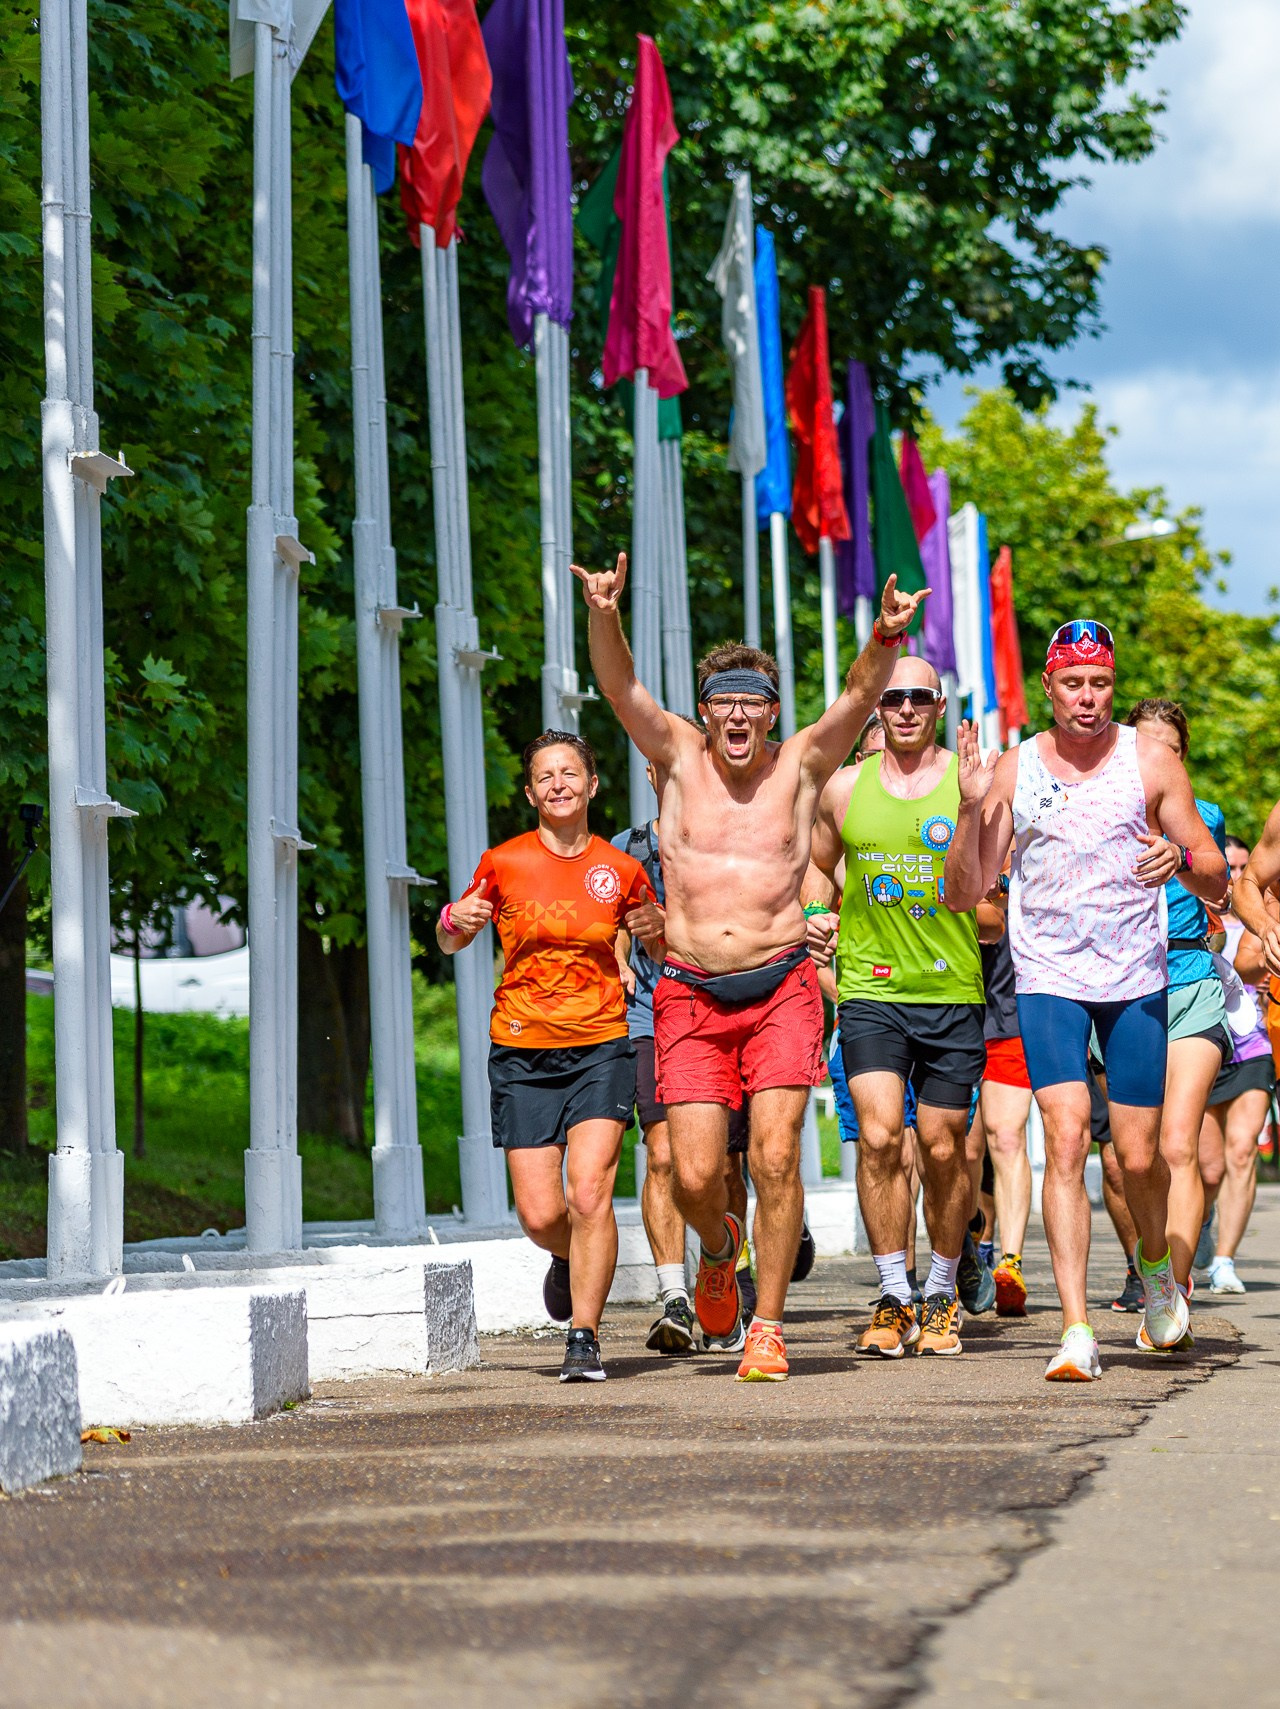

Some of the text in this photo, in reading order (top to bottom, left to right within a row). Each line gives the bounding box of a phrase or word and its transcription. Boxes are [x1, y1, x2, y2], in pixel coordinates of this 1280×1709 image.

[857, 852, 933, 863] NEVER
[881, 863, 933, 873] GIVE
[904, 874, 934, 883] UP
